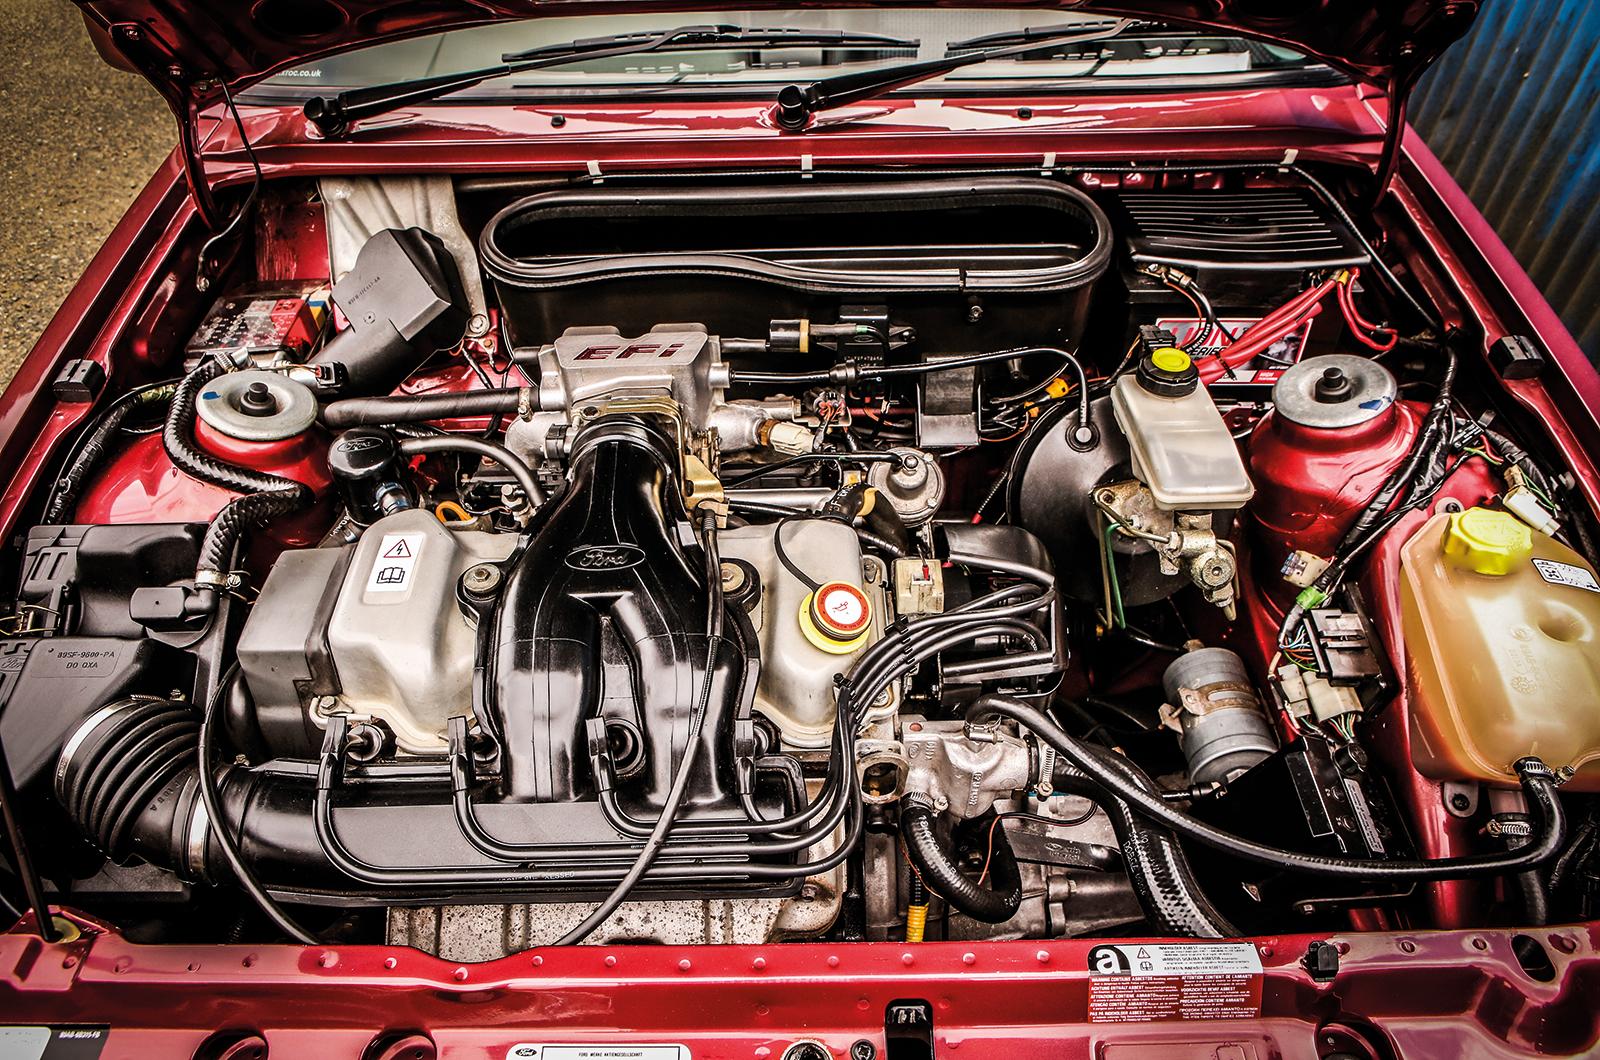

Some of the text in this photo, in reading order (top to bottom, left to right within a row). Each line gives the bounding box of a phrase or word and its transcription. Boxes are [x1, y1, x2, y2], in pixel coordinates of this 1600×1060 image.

[573, 343, 684, 361] EFi
[580, 548, 630, 567] Ford
[1095, 948, 1122, 975] a
